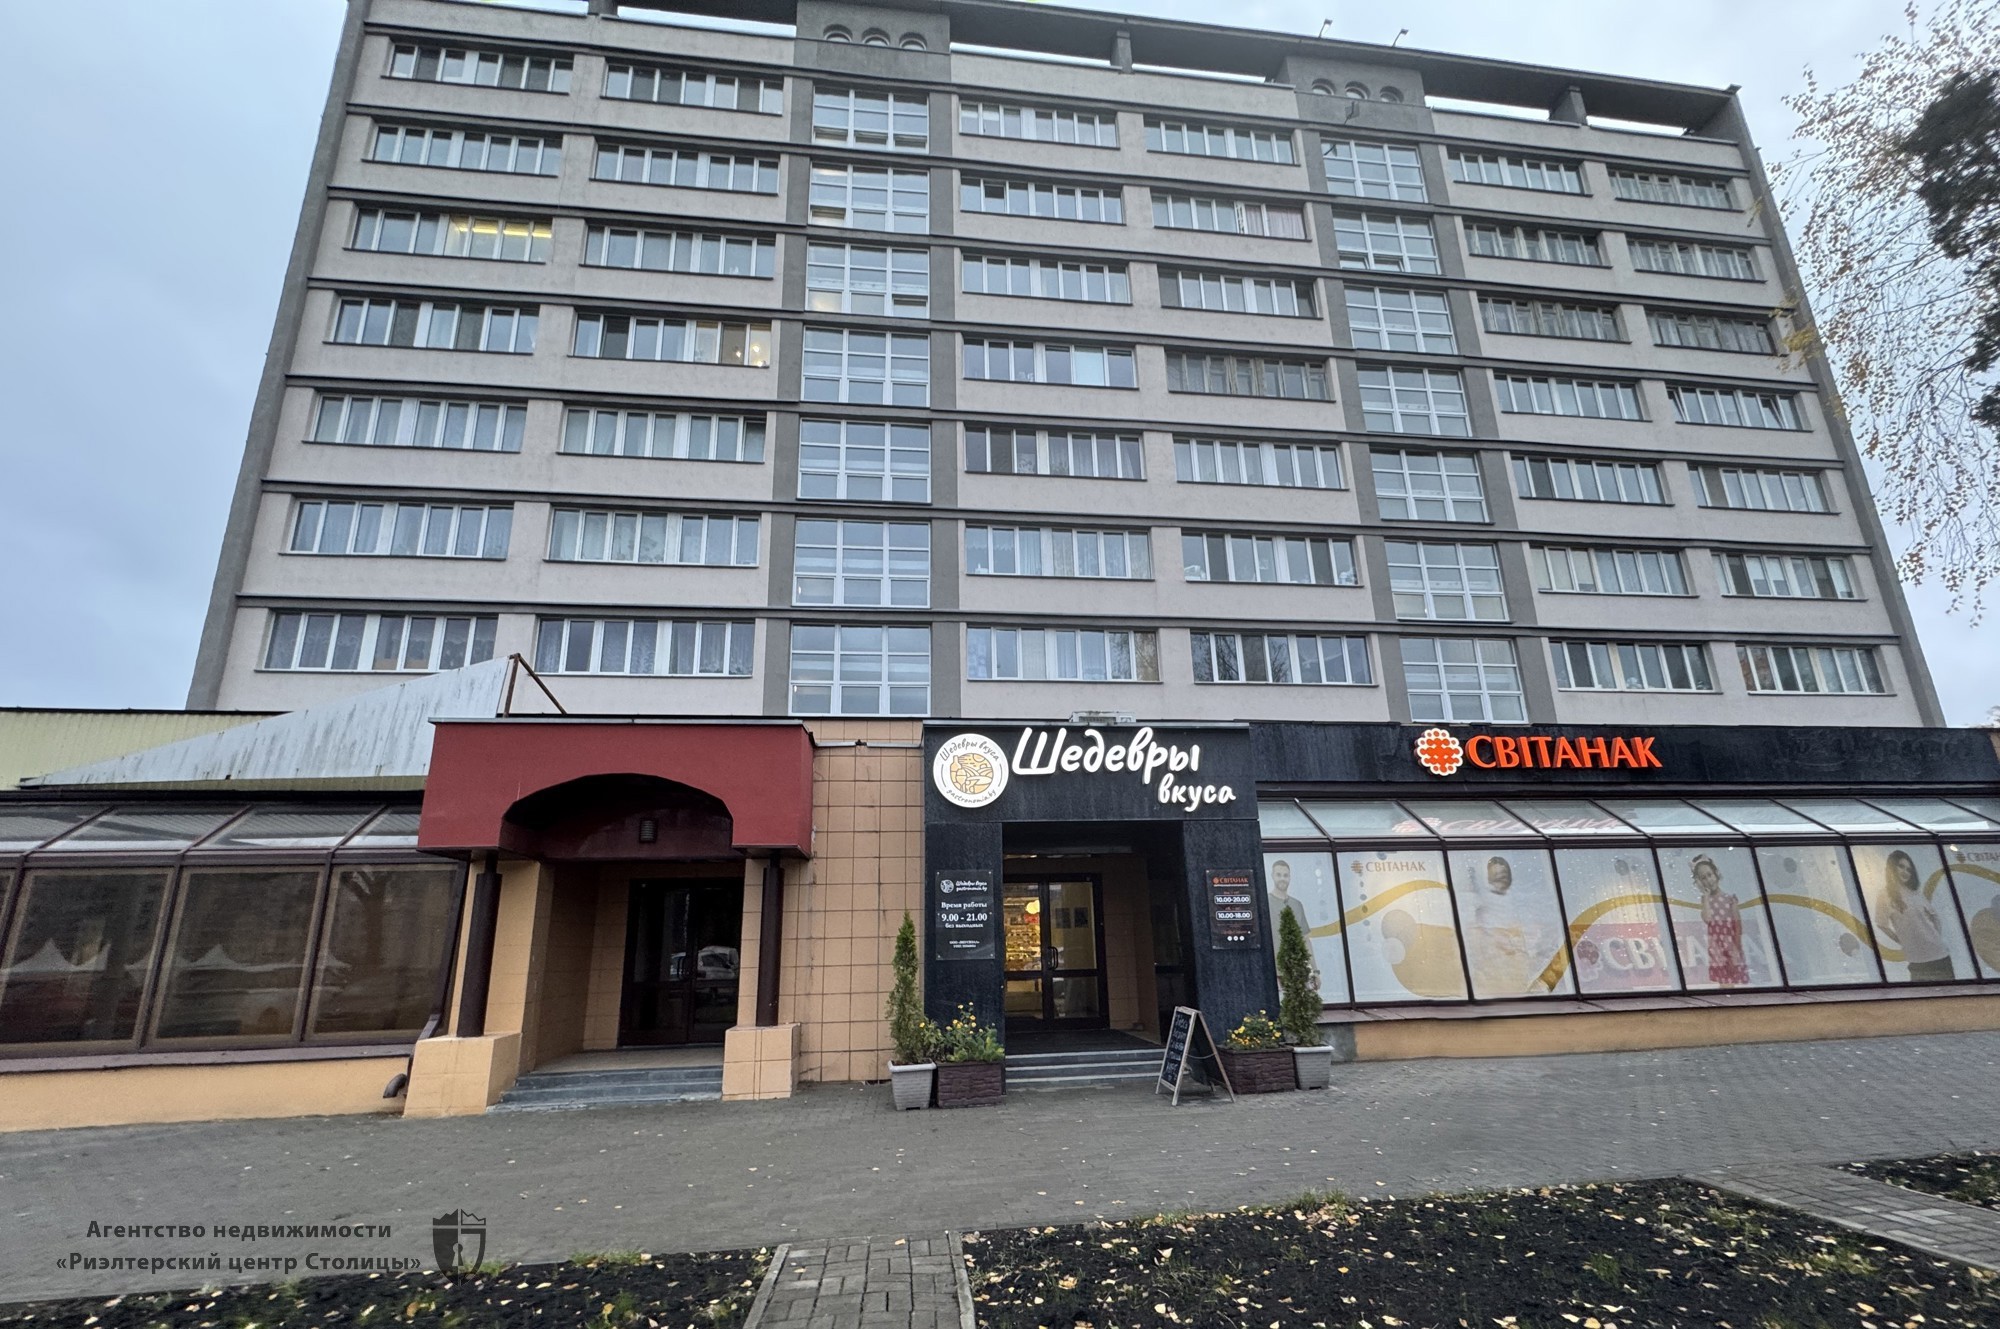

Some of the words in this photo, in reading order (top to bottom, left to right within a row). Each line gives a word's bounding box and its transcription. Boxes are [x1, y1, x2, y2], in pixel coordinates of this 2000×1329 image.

[940, 738, 978, 761] Шедевры
[979, 741, 1000, 761] вкуса
[1012, 727, 1200, 784] Шедевры
[1465, 735, 1663, 768] СВІТАНАК
[1158, 773, 1236, 812] вкуса
[1365, 861, 1426, 873] СВІТАНАК
[941, 901, 962, 910] Время
[963, 901, 987, 910] работы
[941, 913, 959, 922] 9.00
[966, 912, 988, 922] 21.00
